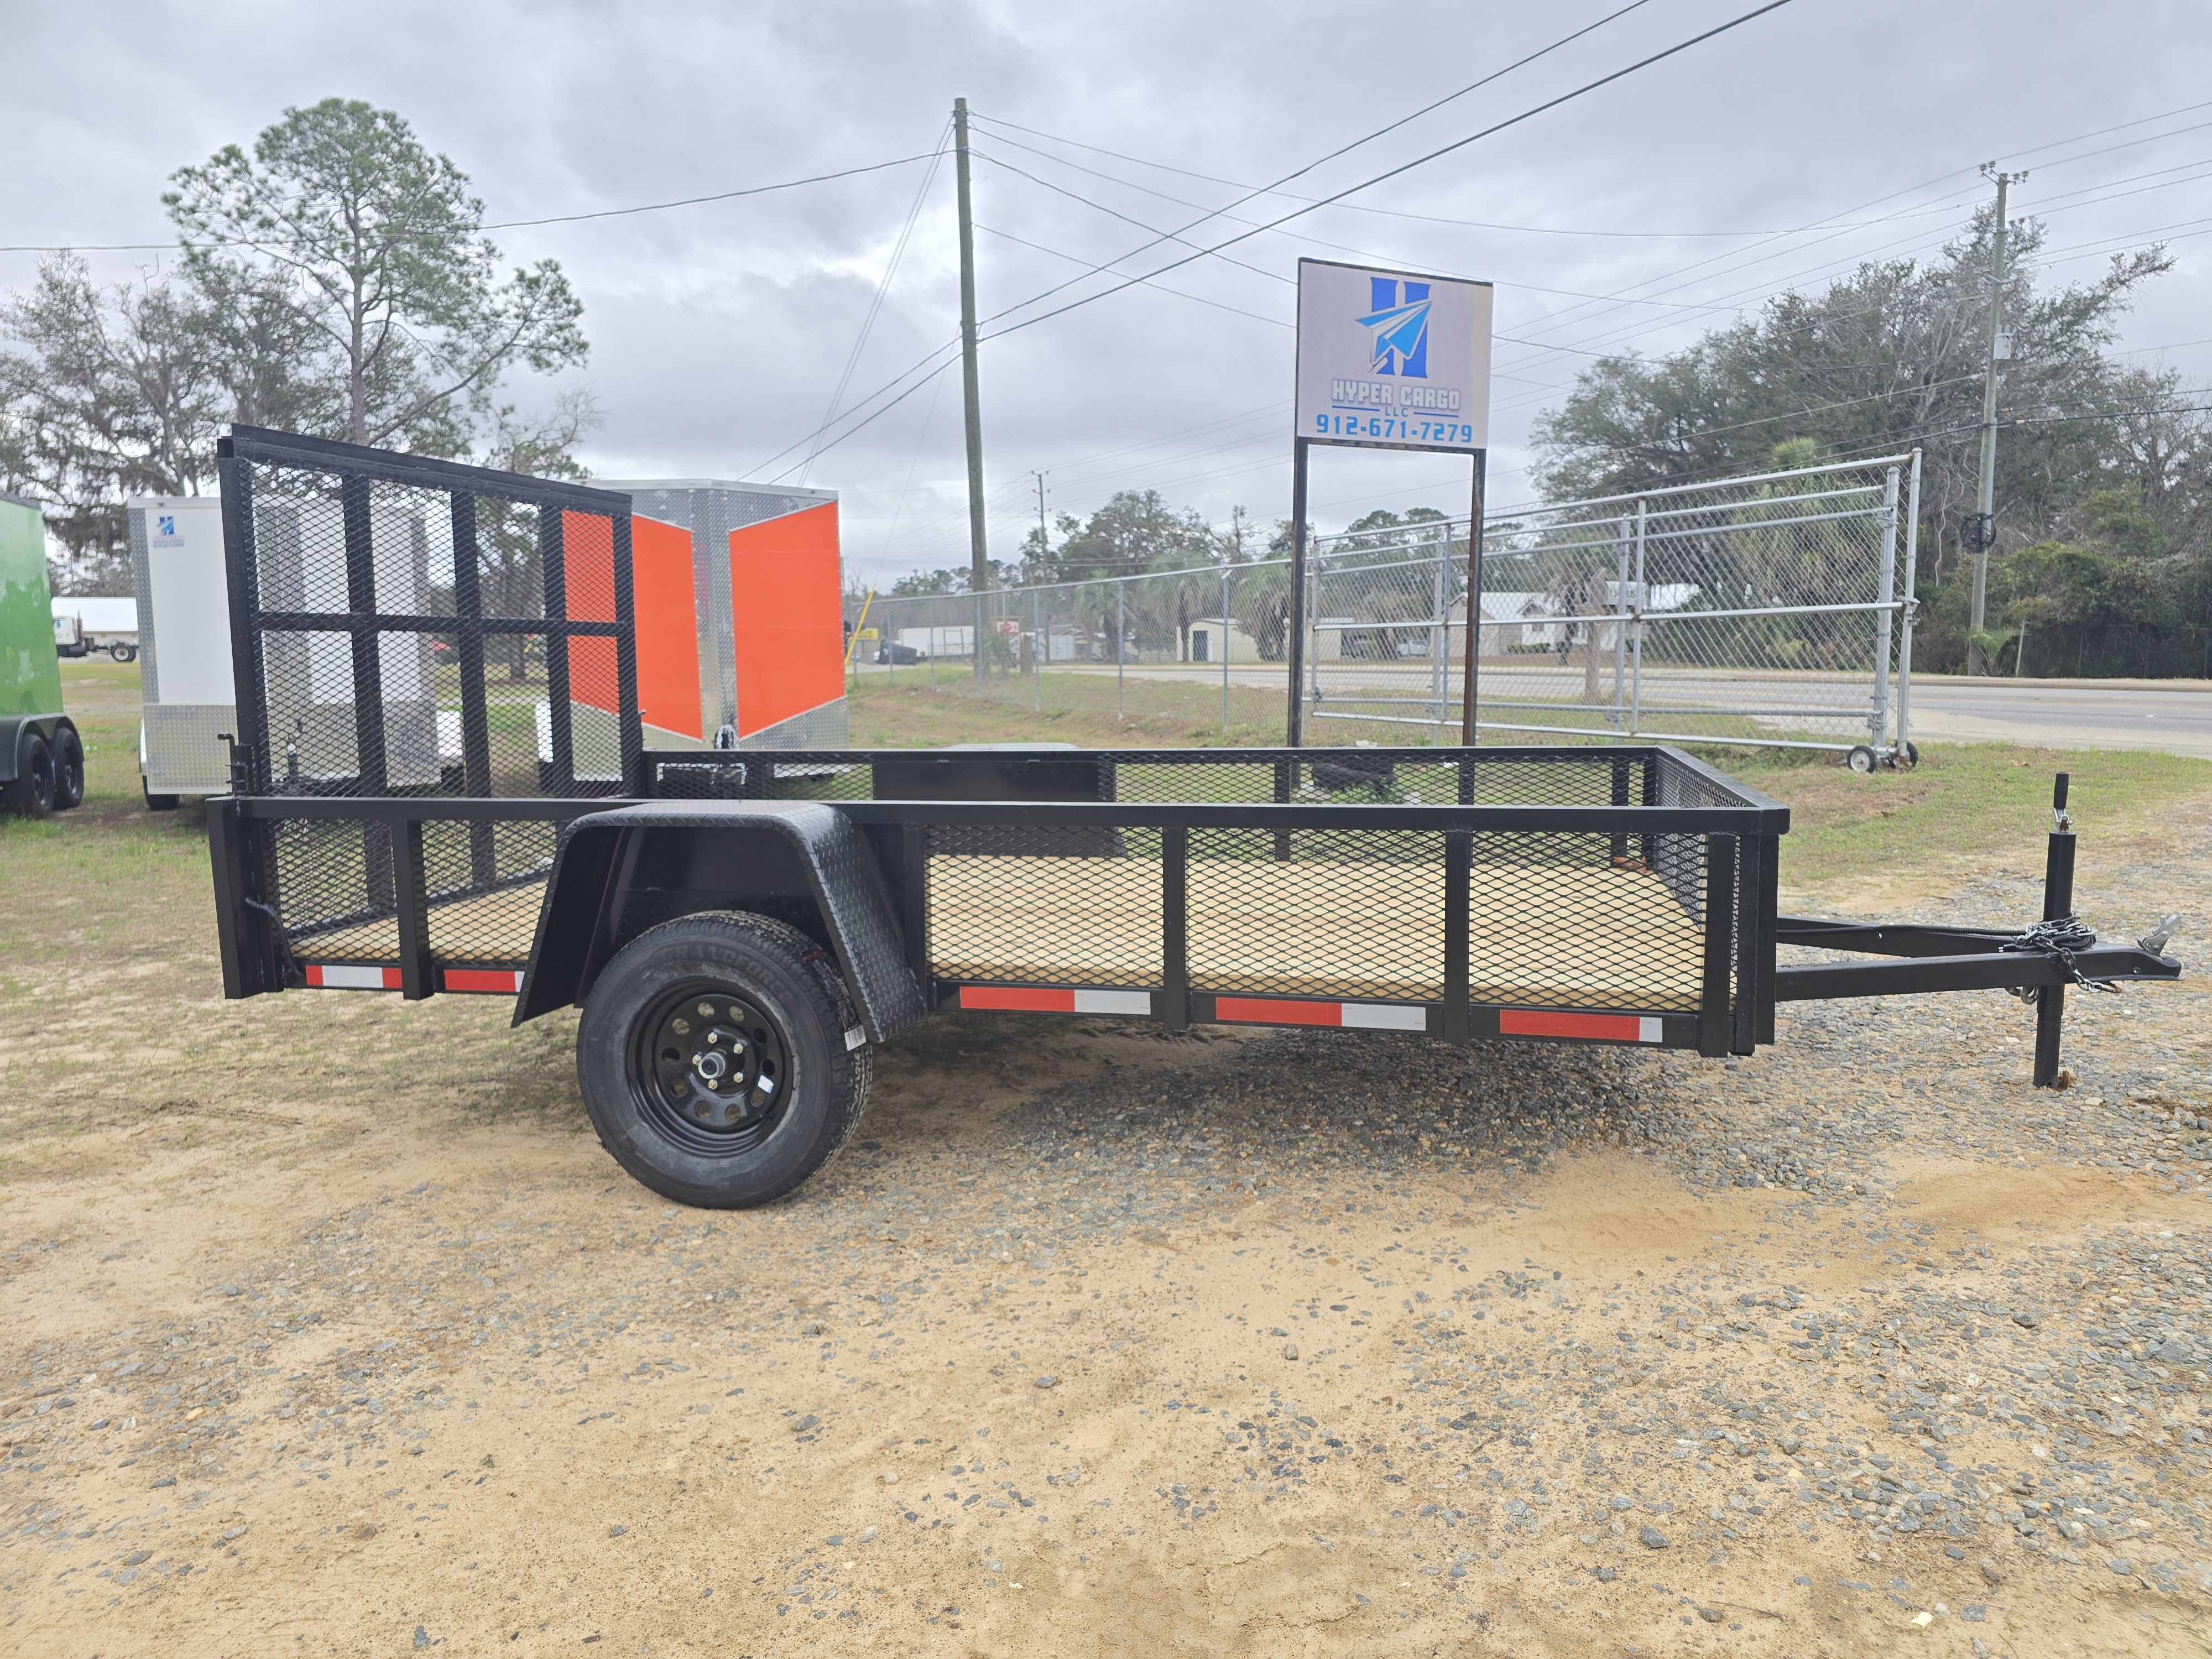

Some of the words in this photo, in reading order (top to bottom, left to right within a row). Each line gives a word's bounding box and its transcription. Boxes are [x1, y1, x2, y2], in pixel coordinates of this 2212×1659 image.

[1332, 379, 1393, 405] HYPER
[1400, 385, 1461, 410] CARGO
[1385, 406, 1409, 418] LLC
[1316, 414, 1472, 442] 912-671-7279
